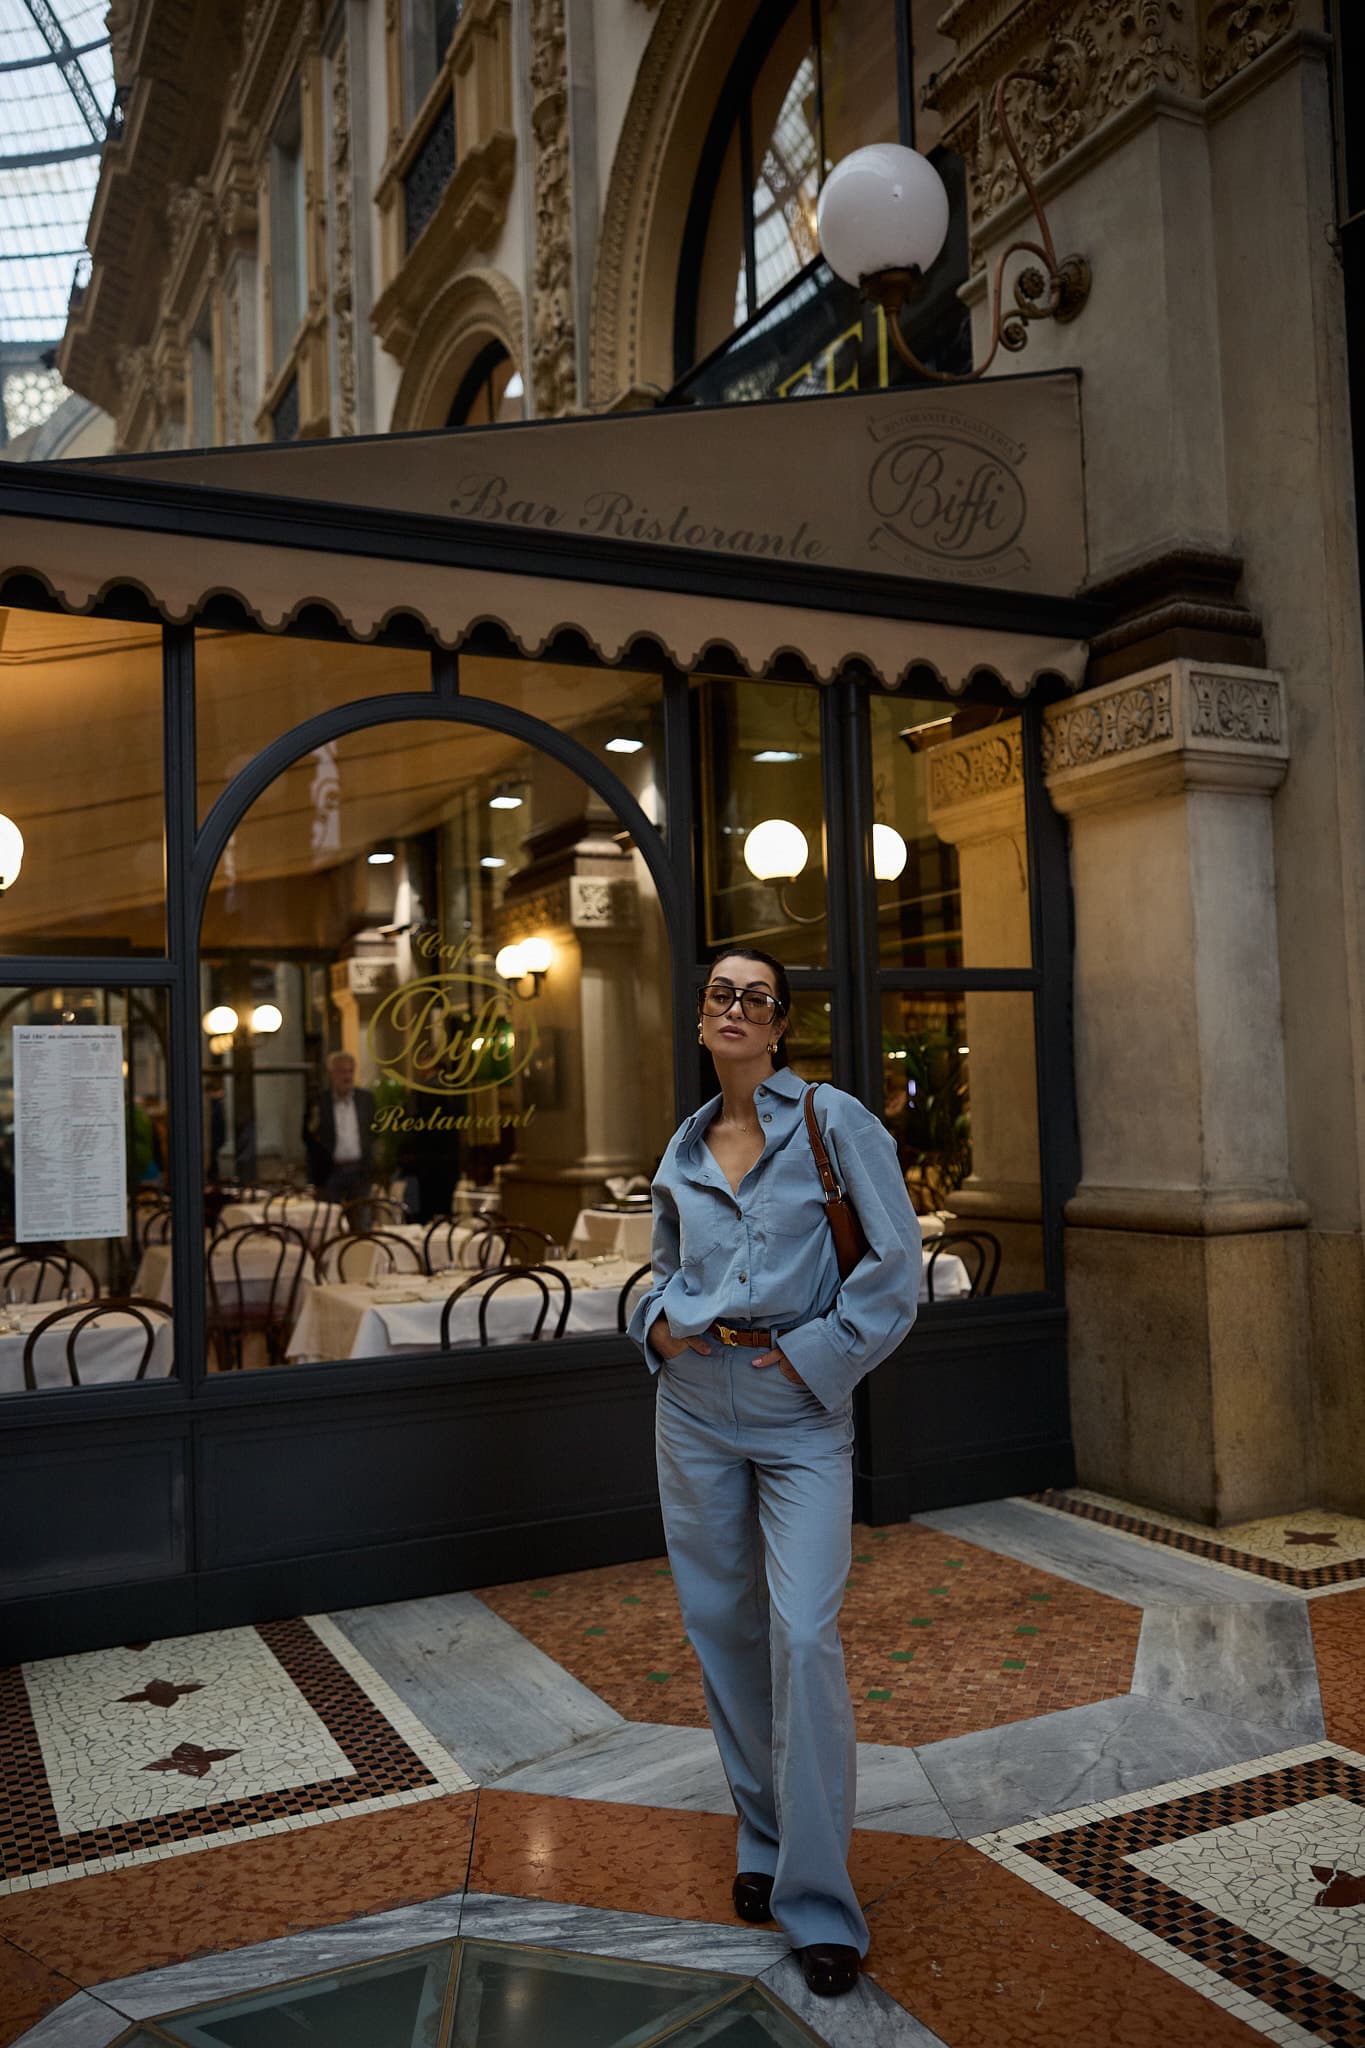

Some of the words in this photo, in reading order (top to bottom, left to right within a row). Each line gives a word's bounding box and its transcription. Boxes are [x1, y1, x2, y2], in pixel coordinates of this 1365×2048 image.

[449, 472, 567, 528] Bar
[579, 490, 831, 559] Ristorante
[868, 444, 1005, 551] Biffi
[368, 985, 514, 1088] Biffi
[370, 1104, 536, 1133] Restaurant
